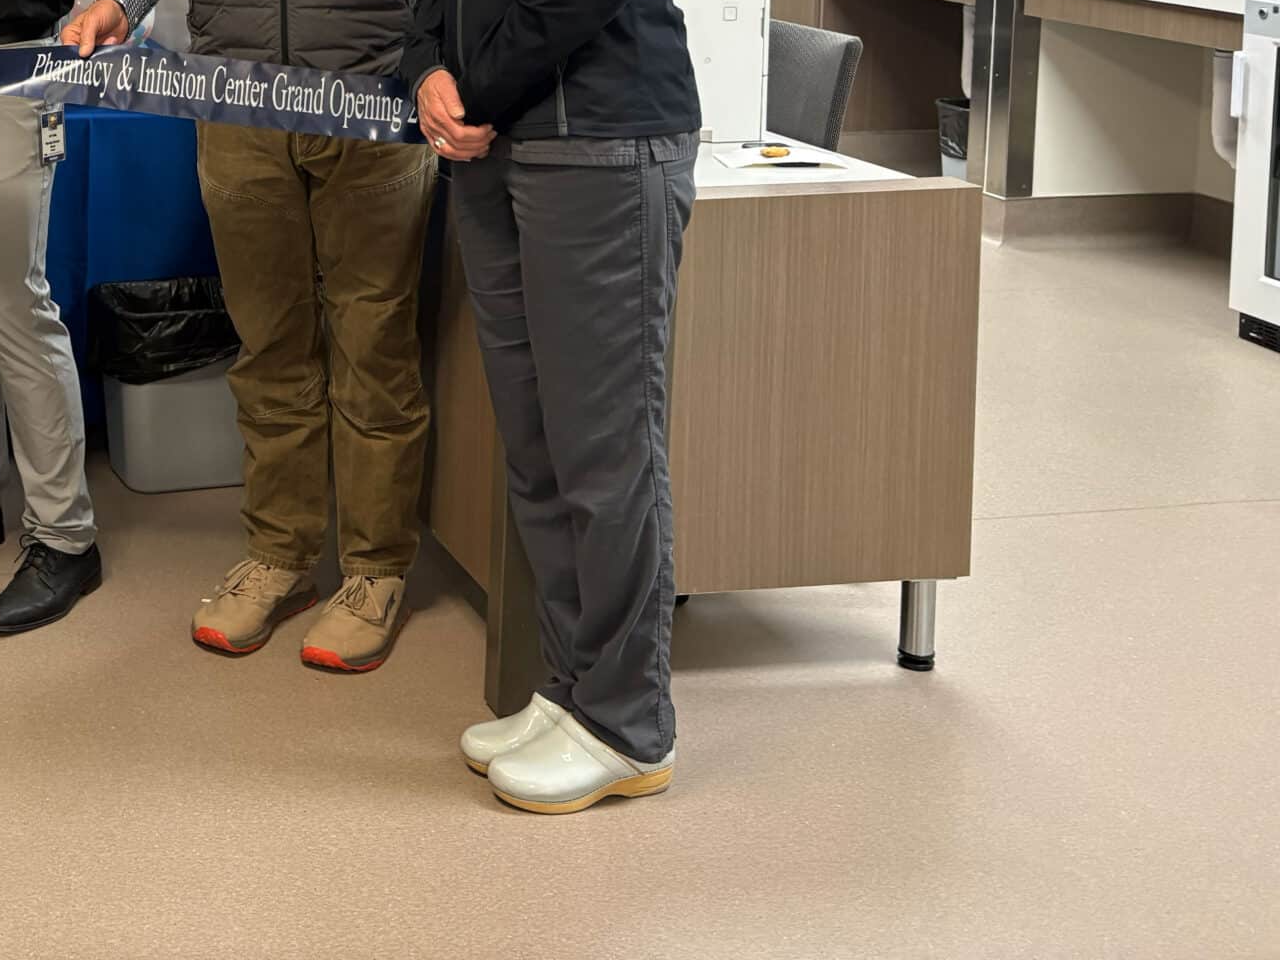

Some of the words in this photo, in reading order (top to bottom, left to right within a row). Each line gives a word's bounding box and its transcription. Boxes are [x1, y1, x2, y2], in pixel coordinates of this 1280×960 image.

[31, 53, 114, 98] Pharmacy
[117, 54, 133, 91] &
[137, 56, 207, 100] Infusion
[212, 65, 268, 108] Center
[272, 72, 325, 114] Grand
[330, 79, 403, 132] Opening
